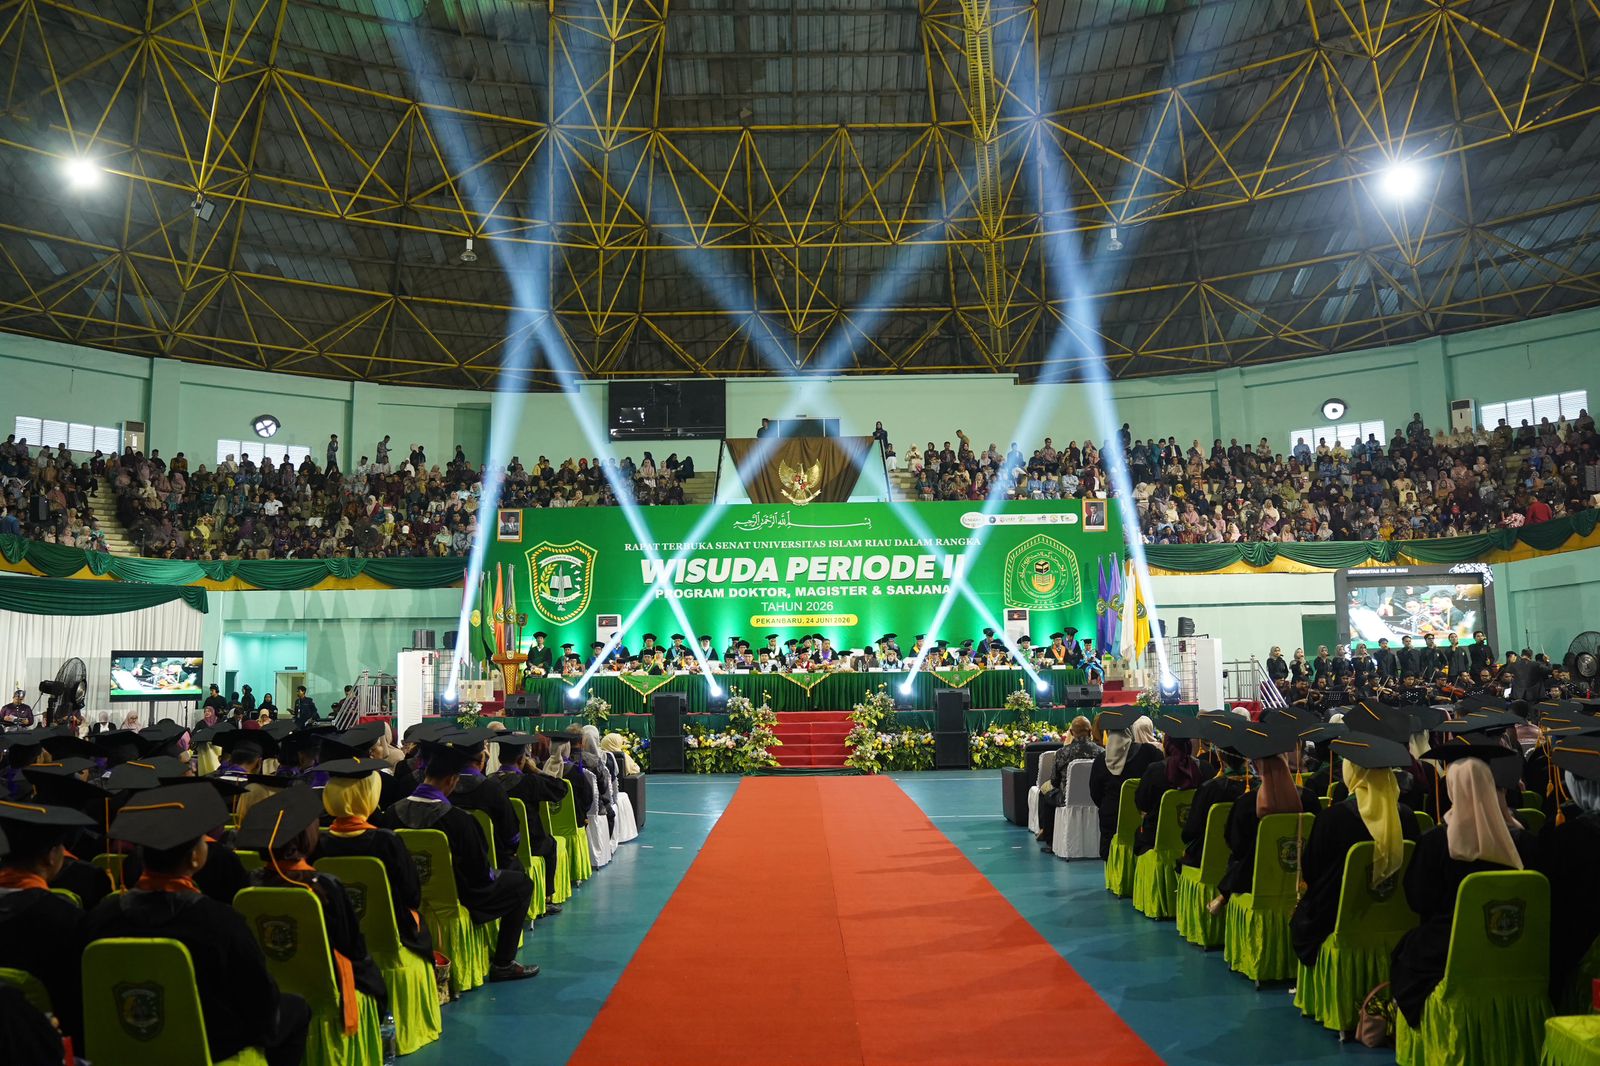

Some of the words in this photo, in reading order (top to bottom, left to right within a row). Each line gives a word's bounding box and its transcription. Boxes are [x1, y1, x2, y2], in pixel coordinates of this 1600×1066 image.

[624, 543, 660, 551] RAPAT
[662, 542, 713, 551] TERBUKA
[715, 541, 751, 550] SENAT
[753, 540, 826, 549] UNIVERSITAS
[828, 540, 862, 548] ISLAM
[865, 539, 892, 547] RIAU
[894, 538, 932, 547] DALAM
[935, 537, 981, 546] RANGKA
[640, 556, 779, 584] WISUDA
[786, 554, 937, 582] PERIODE
[655, 588, 725, 599] PROGRAM
[729, 587, 791, 599] DOKTOR,
[795, 586, 868, 597] MAGISTER
[872, 585, 883, 596] &
[886, 584, 951, 596] SARJANA
[760, 601, 803, 612] TAHUN
[806, 601, 834, 612] 2026
[755, 617, 805, 625] PEKANBARU,
[834, 616, 851, 624] 2026
